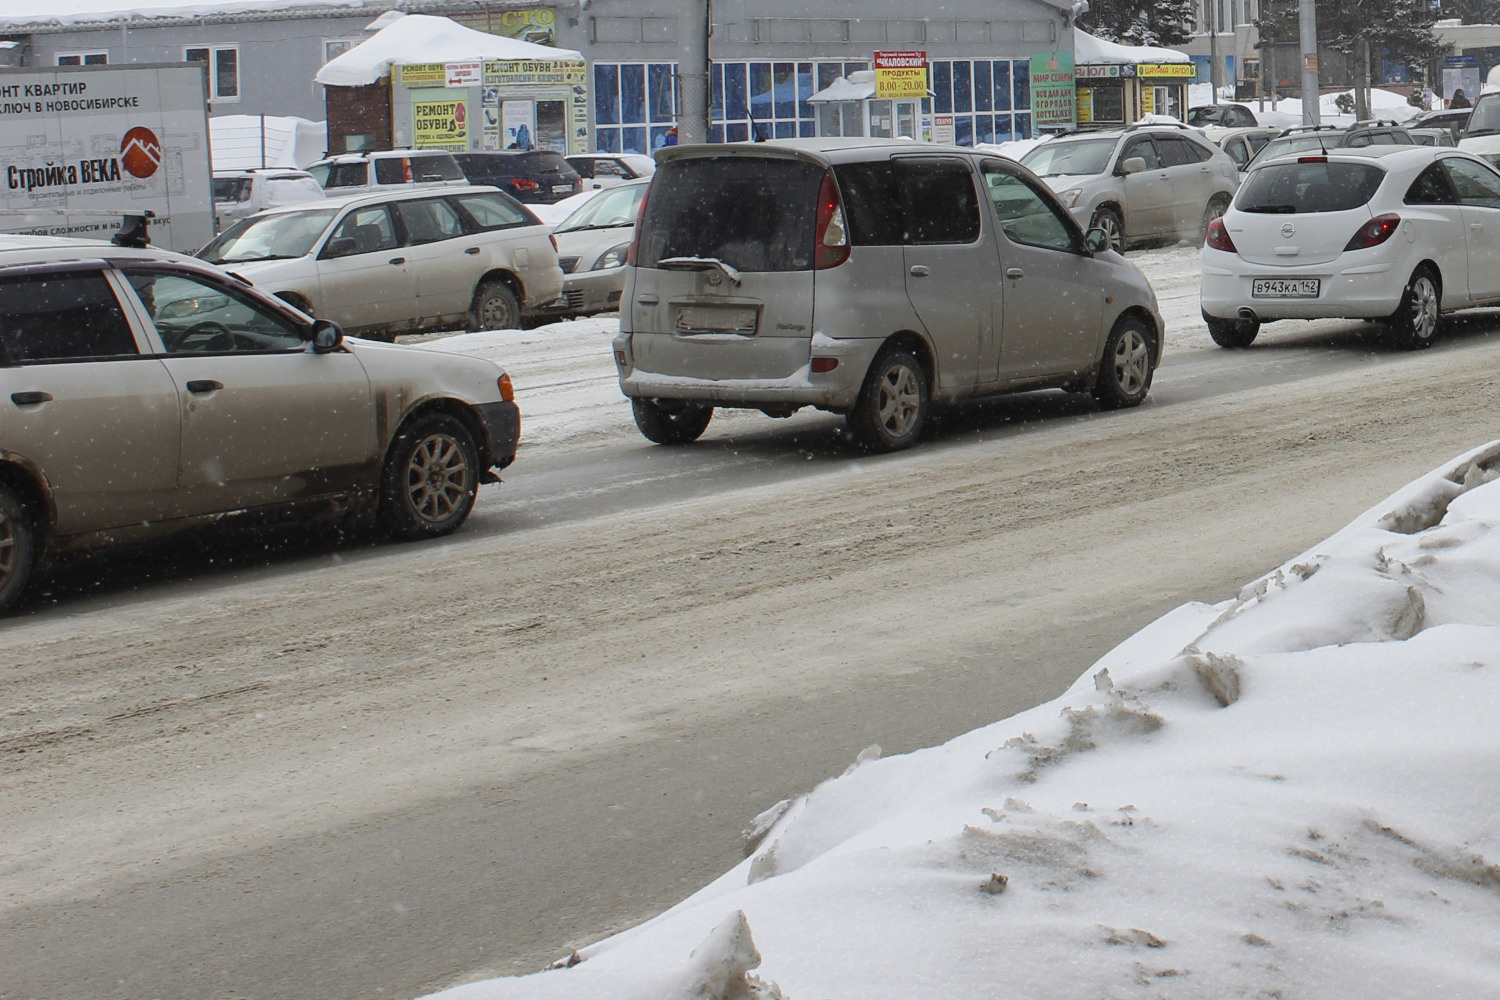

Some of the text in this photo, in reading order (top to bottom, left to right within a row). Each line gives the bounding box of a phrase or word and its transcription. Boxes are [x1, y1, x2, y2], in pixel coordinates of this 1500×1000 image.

[502, 9, 556, 27] СТО
[485, 62, 520, 73] РЕМОНТ
[523, 62, 551, 73] ОБУВИ
[1145, 66, 1169, 75] ШАУРМА
[1033, 74, 1050, 83] МИР
[0, 82, 87, 98] НТ КВАРТИР
[880, 81, 897, 91] 8.00
[902, 80, 924, 91] 20.00
[1036, 90, 1047, 98] ВСЕ
[35, 101, 43, 113] В
[46, 96, 139, 112] НОВОСИБИРСКЕ
[1036, 99, 1072, 108] ОГОРОДОВ
[416, 104, 455, 116] РЕМОНТ
[416, 119, 448, 130] ОБУВИ
[8, 157, 121, 192] Стройка ВЕКА
[123, 183, 147, 193] работы
[50, 224, 100, 236] сложности
[153, 216, 171, 227] вкус
[1256, 280, 1316, 293] В943КА 142
